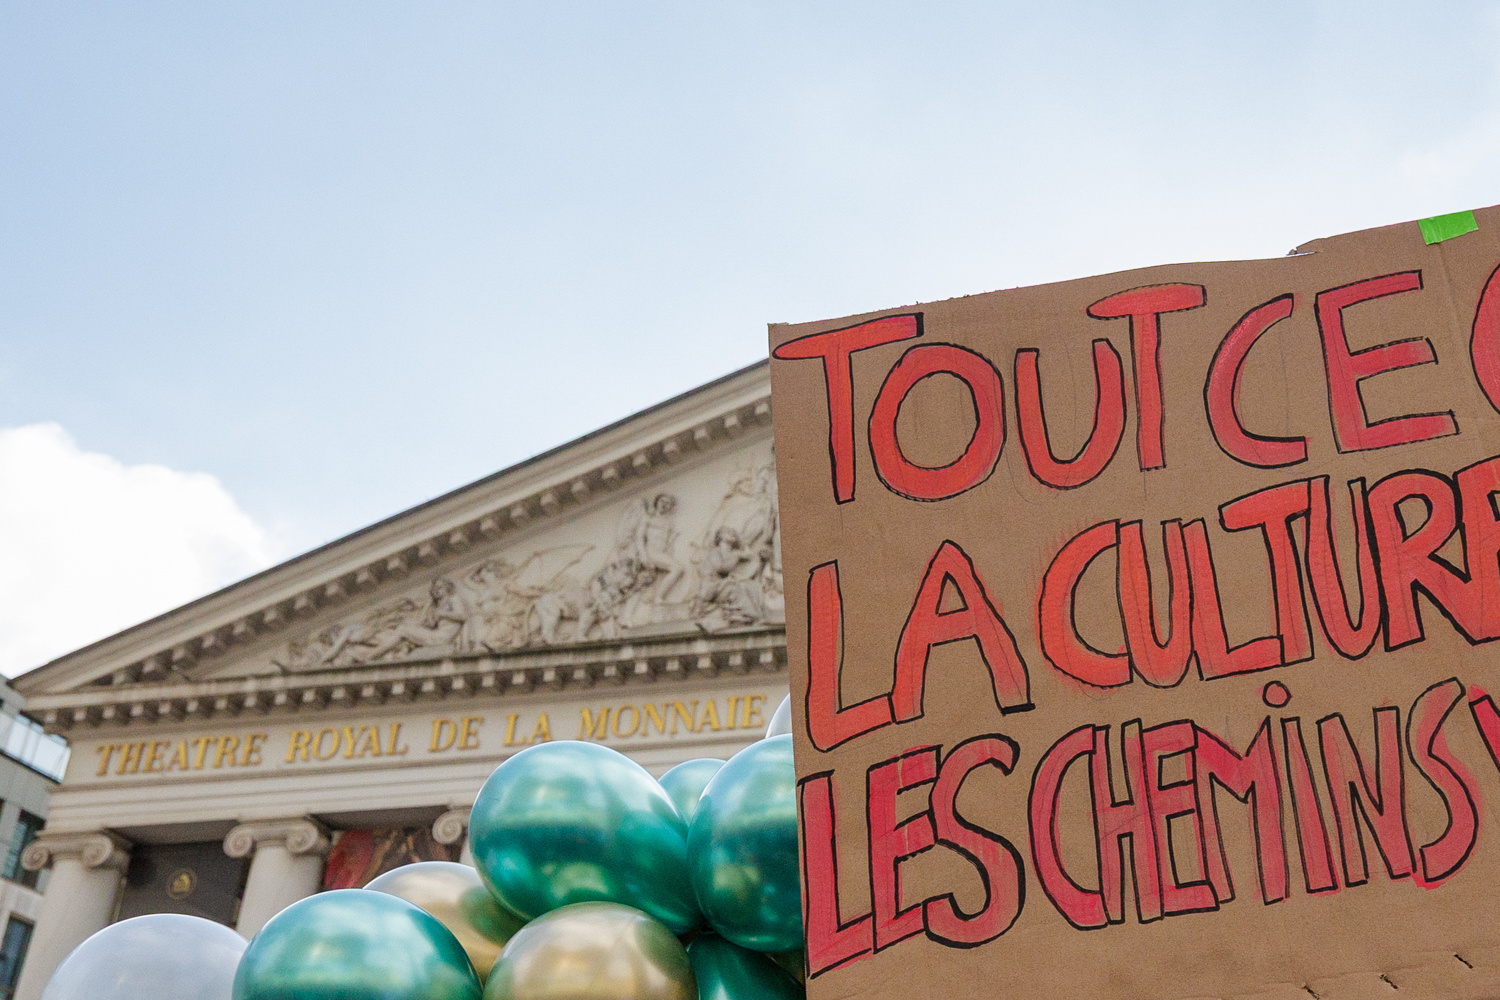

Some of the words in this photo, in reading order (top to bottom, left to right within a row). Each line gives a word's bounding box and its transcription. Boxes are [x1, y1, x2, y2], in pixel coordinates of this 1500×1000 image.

[772, 283, 1207, 504] TOUT
[1203, 270, 1460, 468] CE
[95, 733, 268, 777] THEATRE
[284, 723, 409, 763] ROYAL
[428, 715, 484, 751] DE
[504, 711, 553, 746] LA
[576, 694, 767, 741] MONNAIE
[804, 540, 1036, 752] LA
[798, 735, 1026, 980] LES
